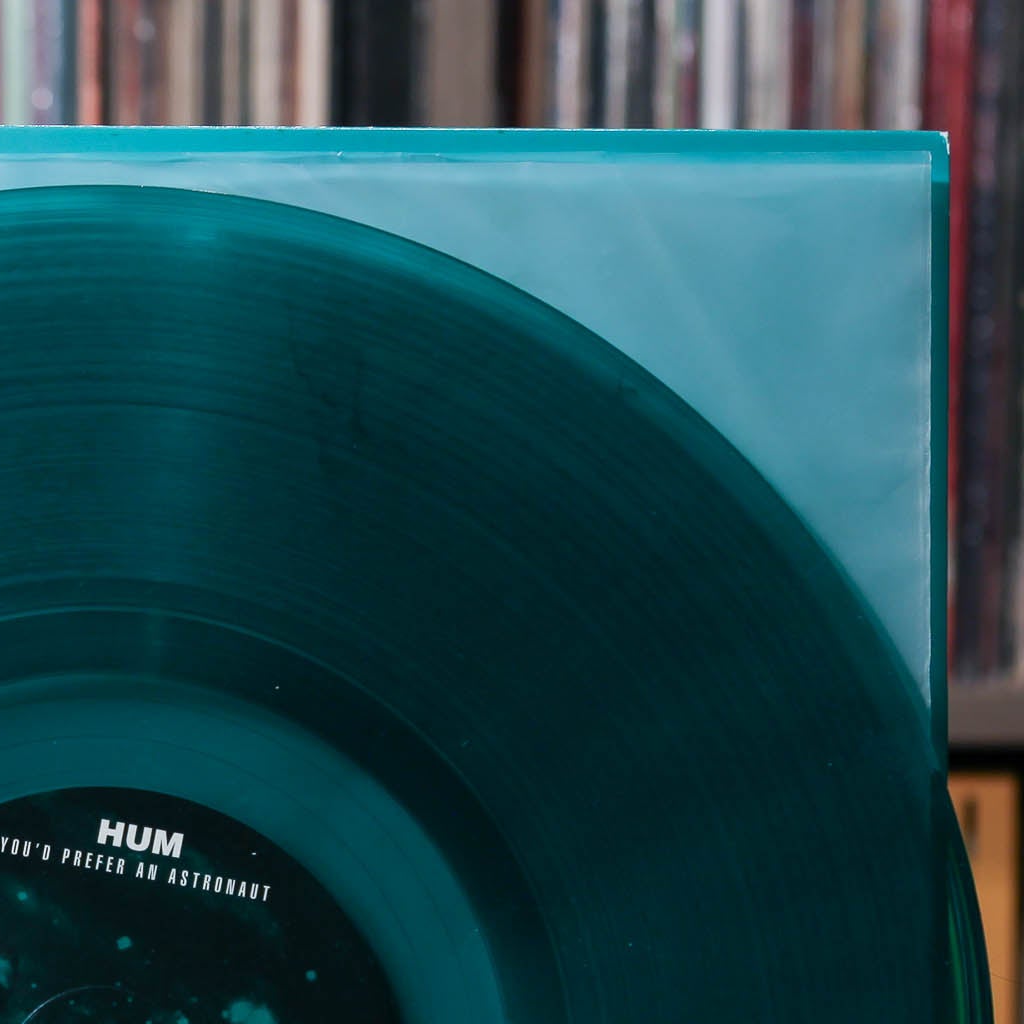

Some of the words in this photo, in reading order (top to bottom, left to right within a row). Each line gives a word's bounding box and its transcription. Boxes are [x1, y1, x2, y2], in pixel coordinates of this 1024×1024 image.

[97, 818, 184, 858] HUM
[0, 836, 51, 861] YOU'D
[62, 848, 126, 875] PREFER
[135, 862, 158, 881] AN
[168, 868, 271, 902] ASTRONAUT
